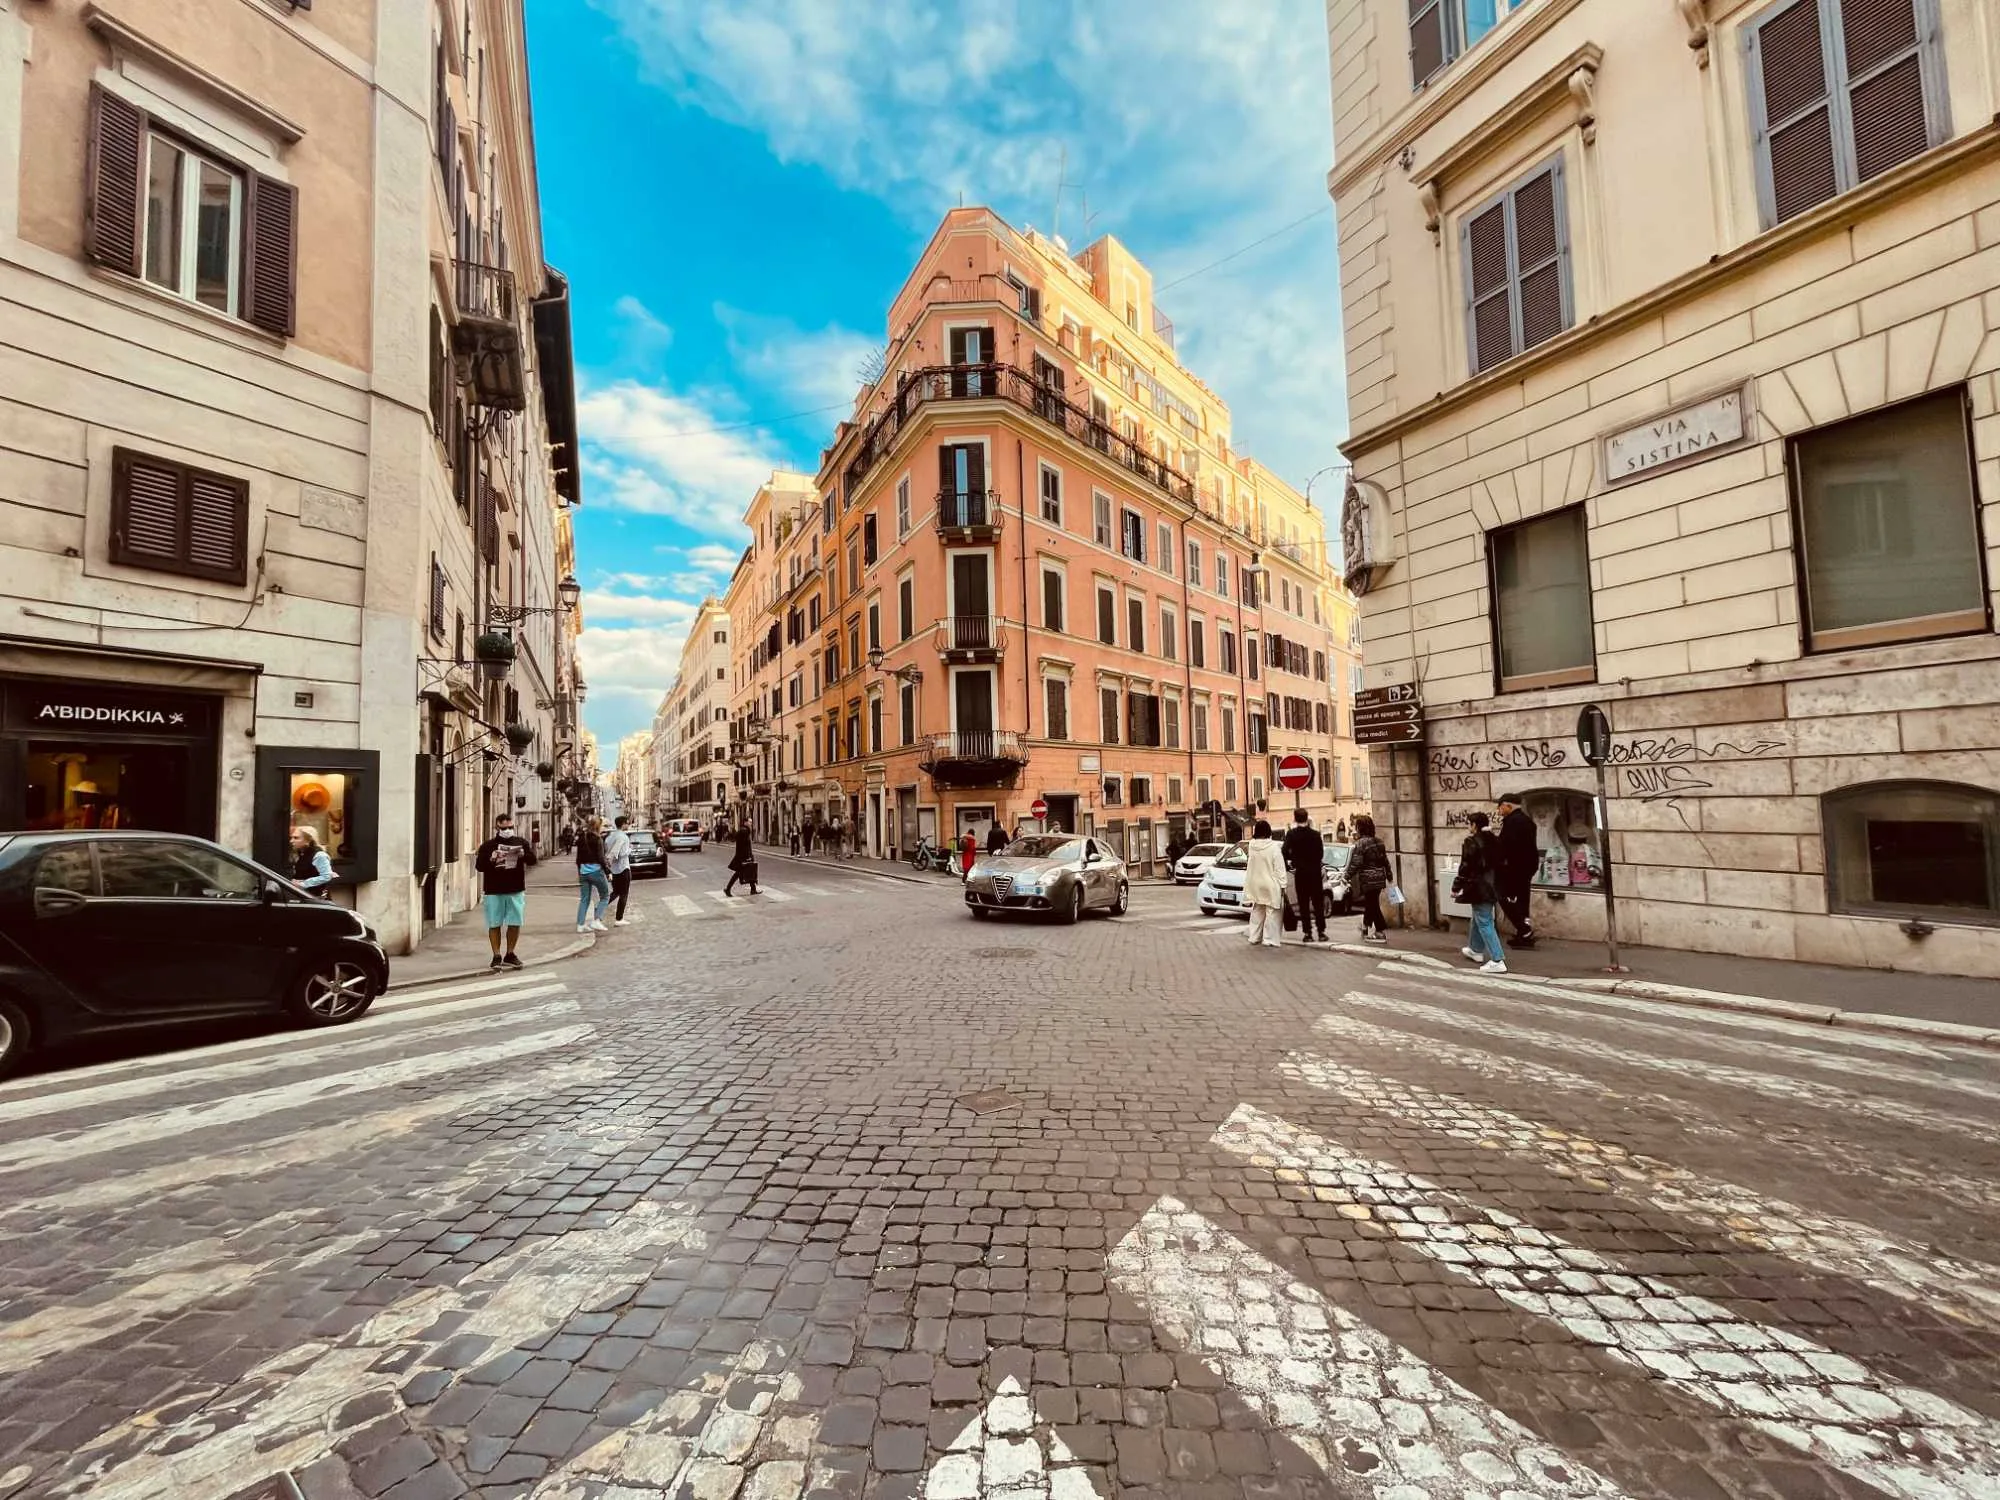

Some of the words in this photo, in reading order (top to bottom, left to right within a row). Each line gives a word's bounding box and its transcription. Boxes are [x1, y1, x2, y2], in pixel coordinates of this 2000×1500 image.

[1653, 419, 1688, 438] VIA
[1627, 431, 1719, 470] SISTINA
[39, 704, 165, 724] A'BIDDIKKIA
